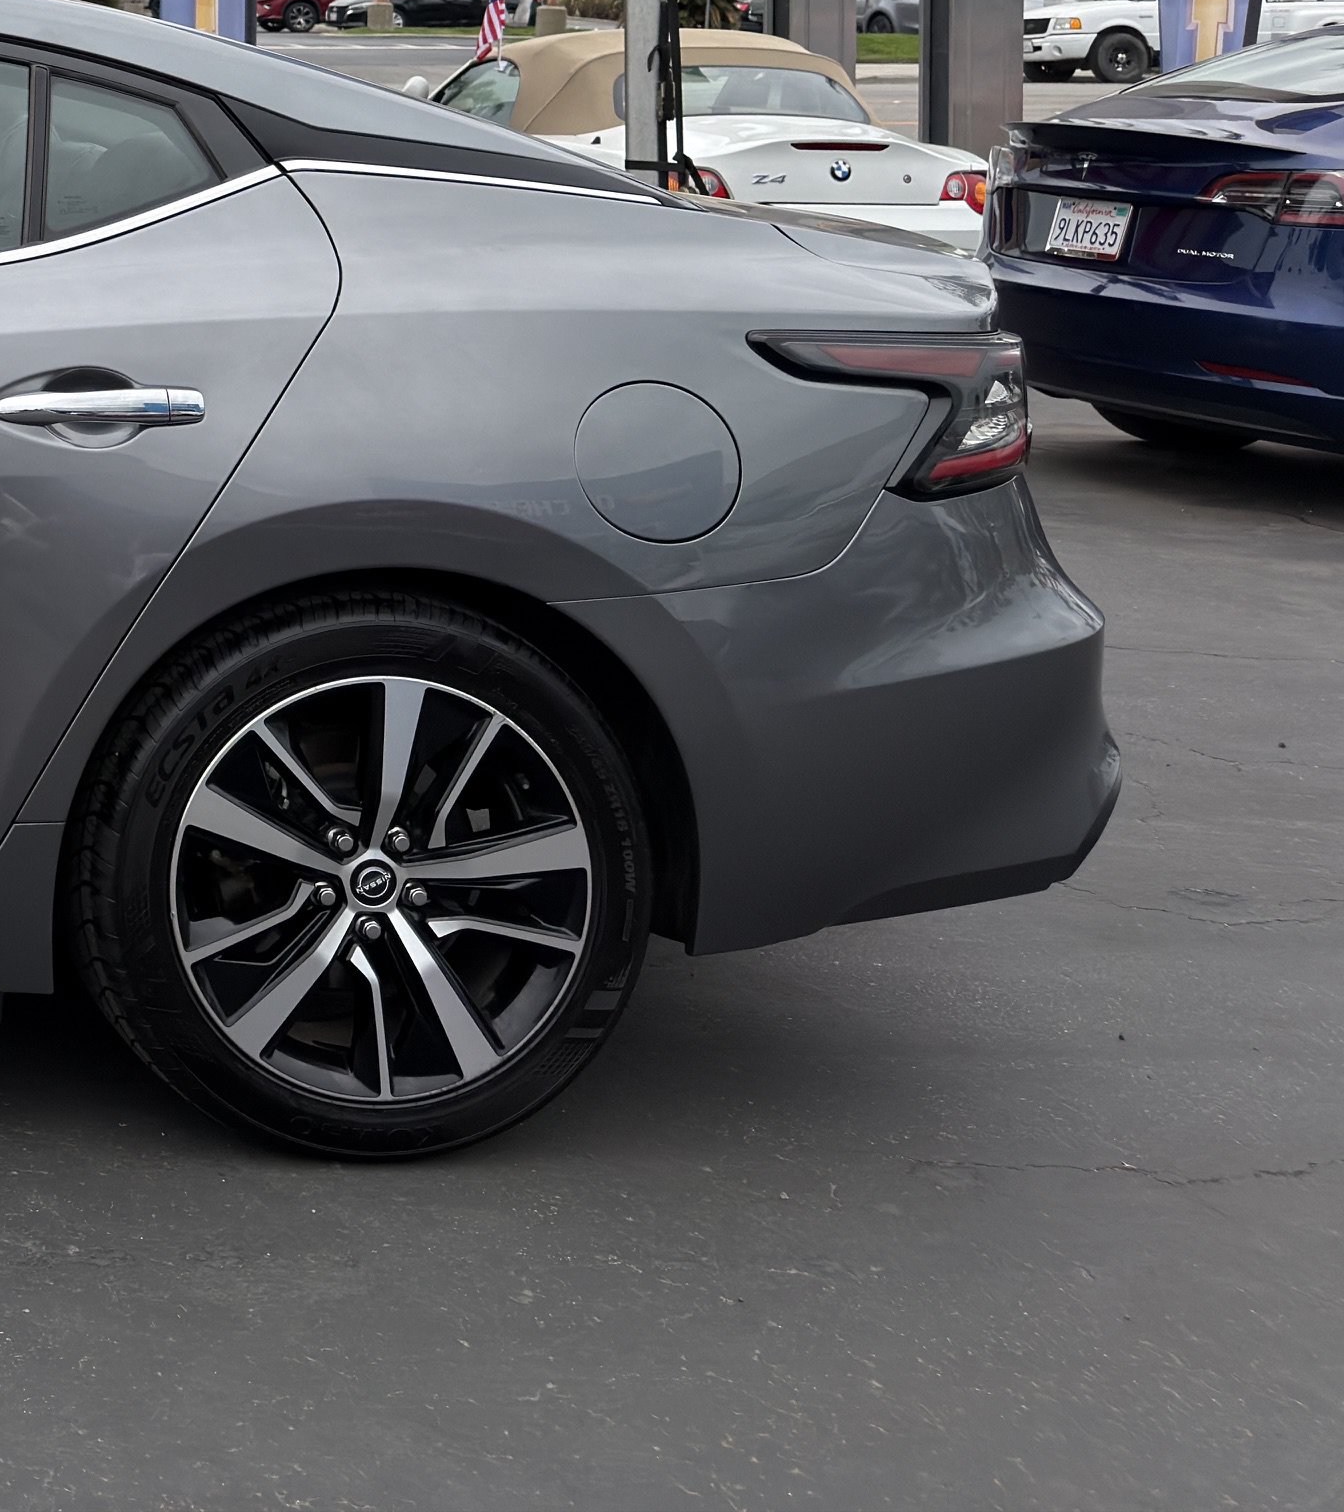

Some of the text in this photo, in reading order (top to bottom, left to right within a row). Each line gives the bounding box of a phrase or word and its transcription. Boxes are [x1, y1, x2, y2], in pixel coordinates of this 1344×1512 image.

[752, 174, 787, 185] Z4
[1072, 202, 1116, 218] California
[1054, 218, 1121, 248] 9LKP635
[1177, 248, 1234, 259] DUAL MOTOR
[356, 873, 391, 894] NISSAN
